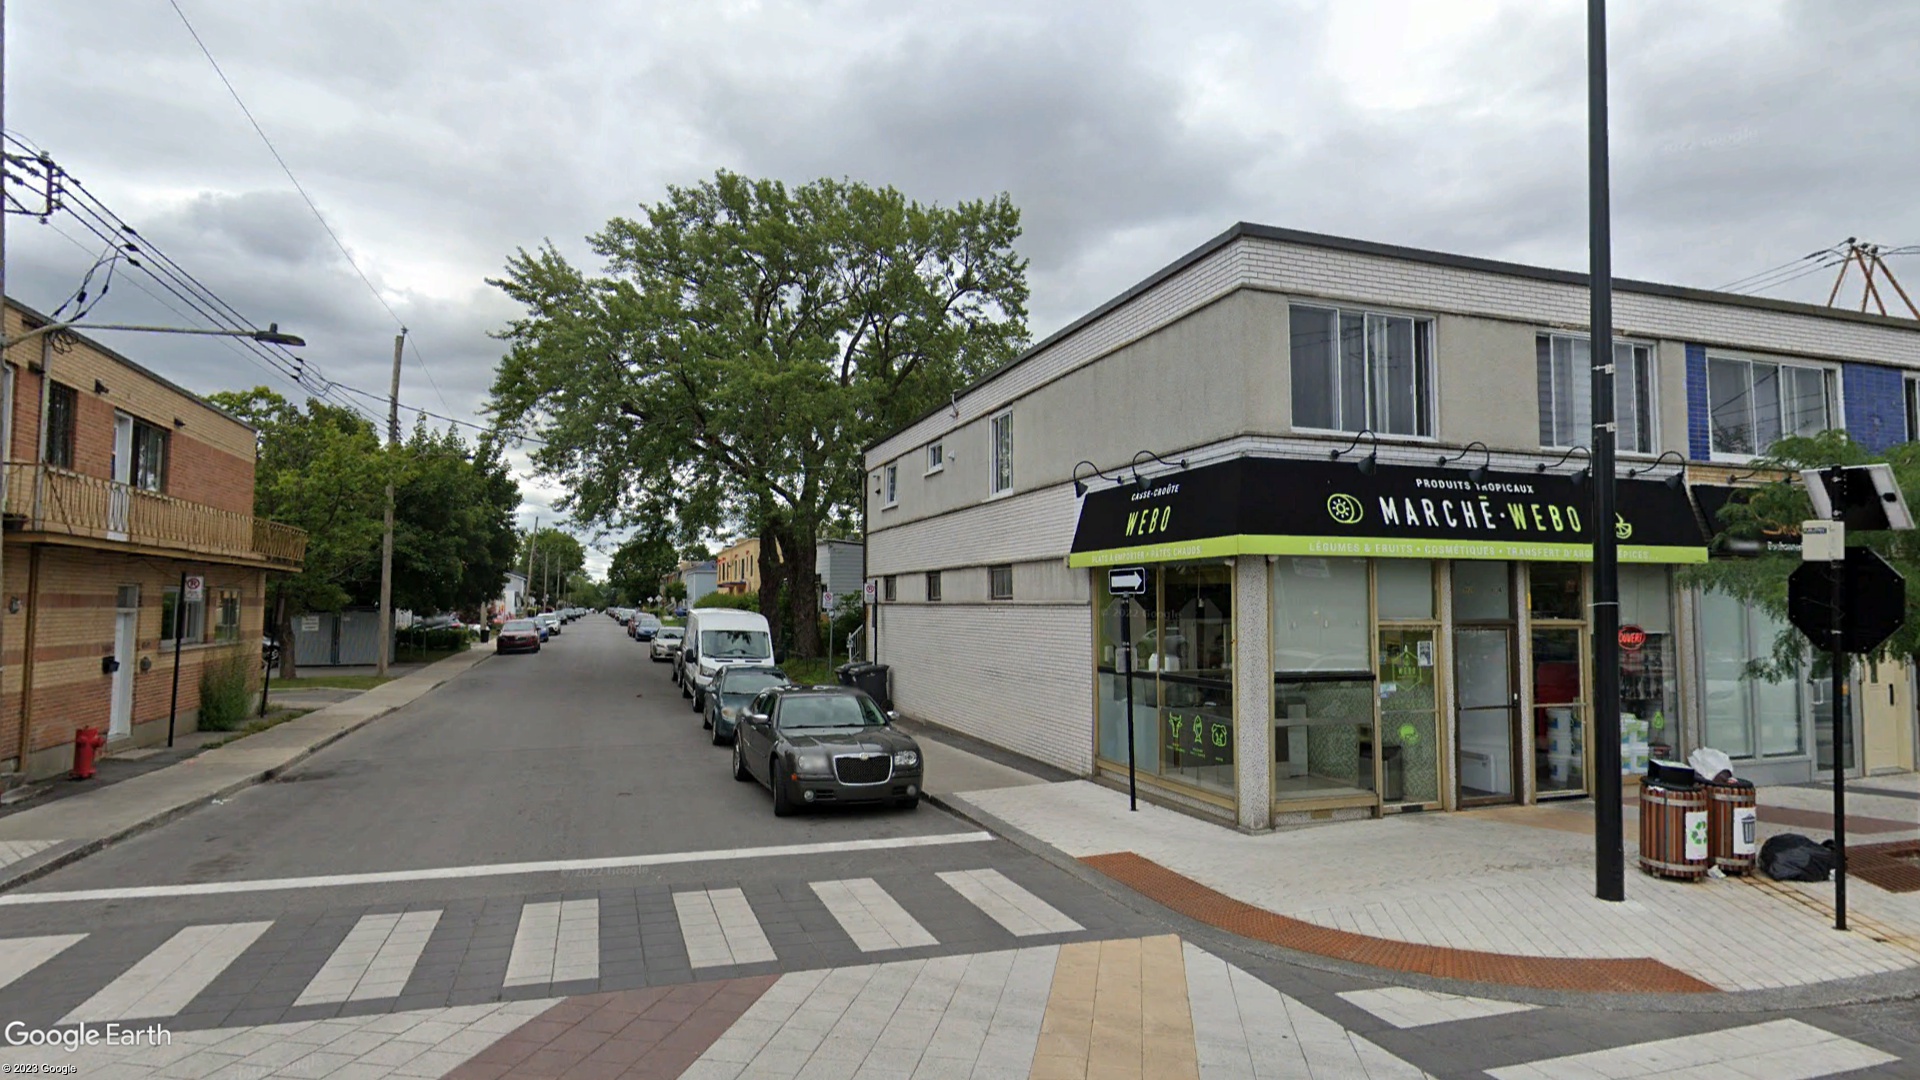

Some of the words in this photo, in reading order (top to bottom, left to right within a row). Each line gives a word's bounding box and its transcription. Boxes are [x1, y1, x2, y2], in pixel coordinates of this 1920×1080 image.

[1416, 478, 1471, 490] PRODUITS
[1125, 505, 1171, 536] WEBO
[1507, 502, 1582, 533] WEBO
[1173, 545, 1202, 557] CHAUDS
[1309, 540, 1360, 553] LÉGUMES
[1364, 543, 1371, 553] &
[1375, 543, 1413, 554] FRUITS
[1424, 542, 1495, 557] COSMÉTIQUES
[1506, 546, 1559, 558] TRANSFERT
